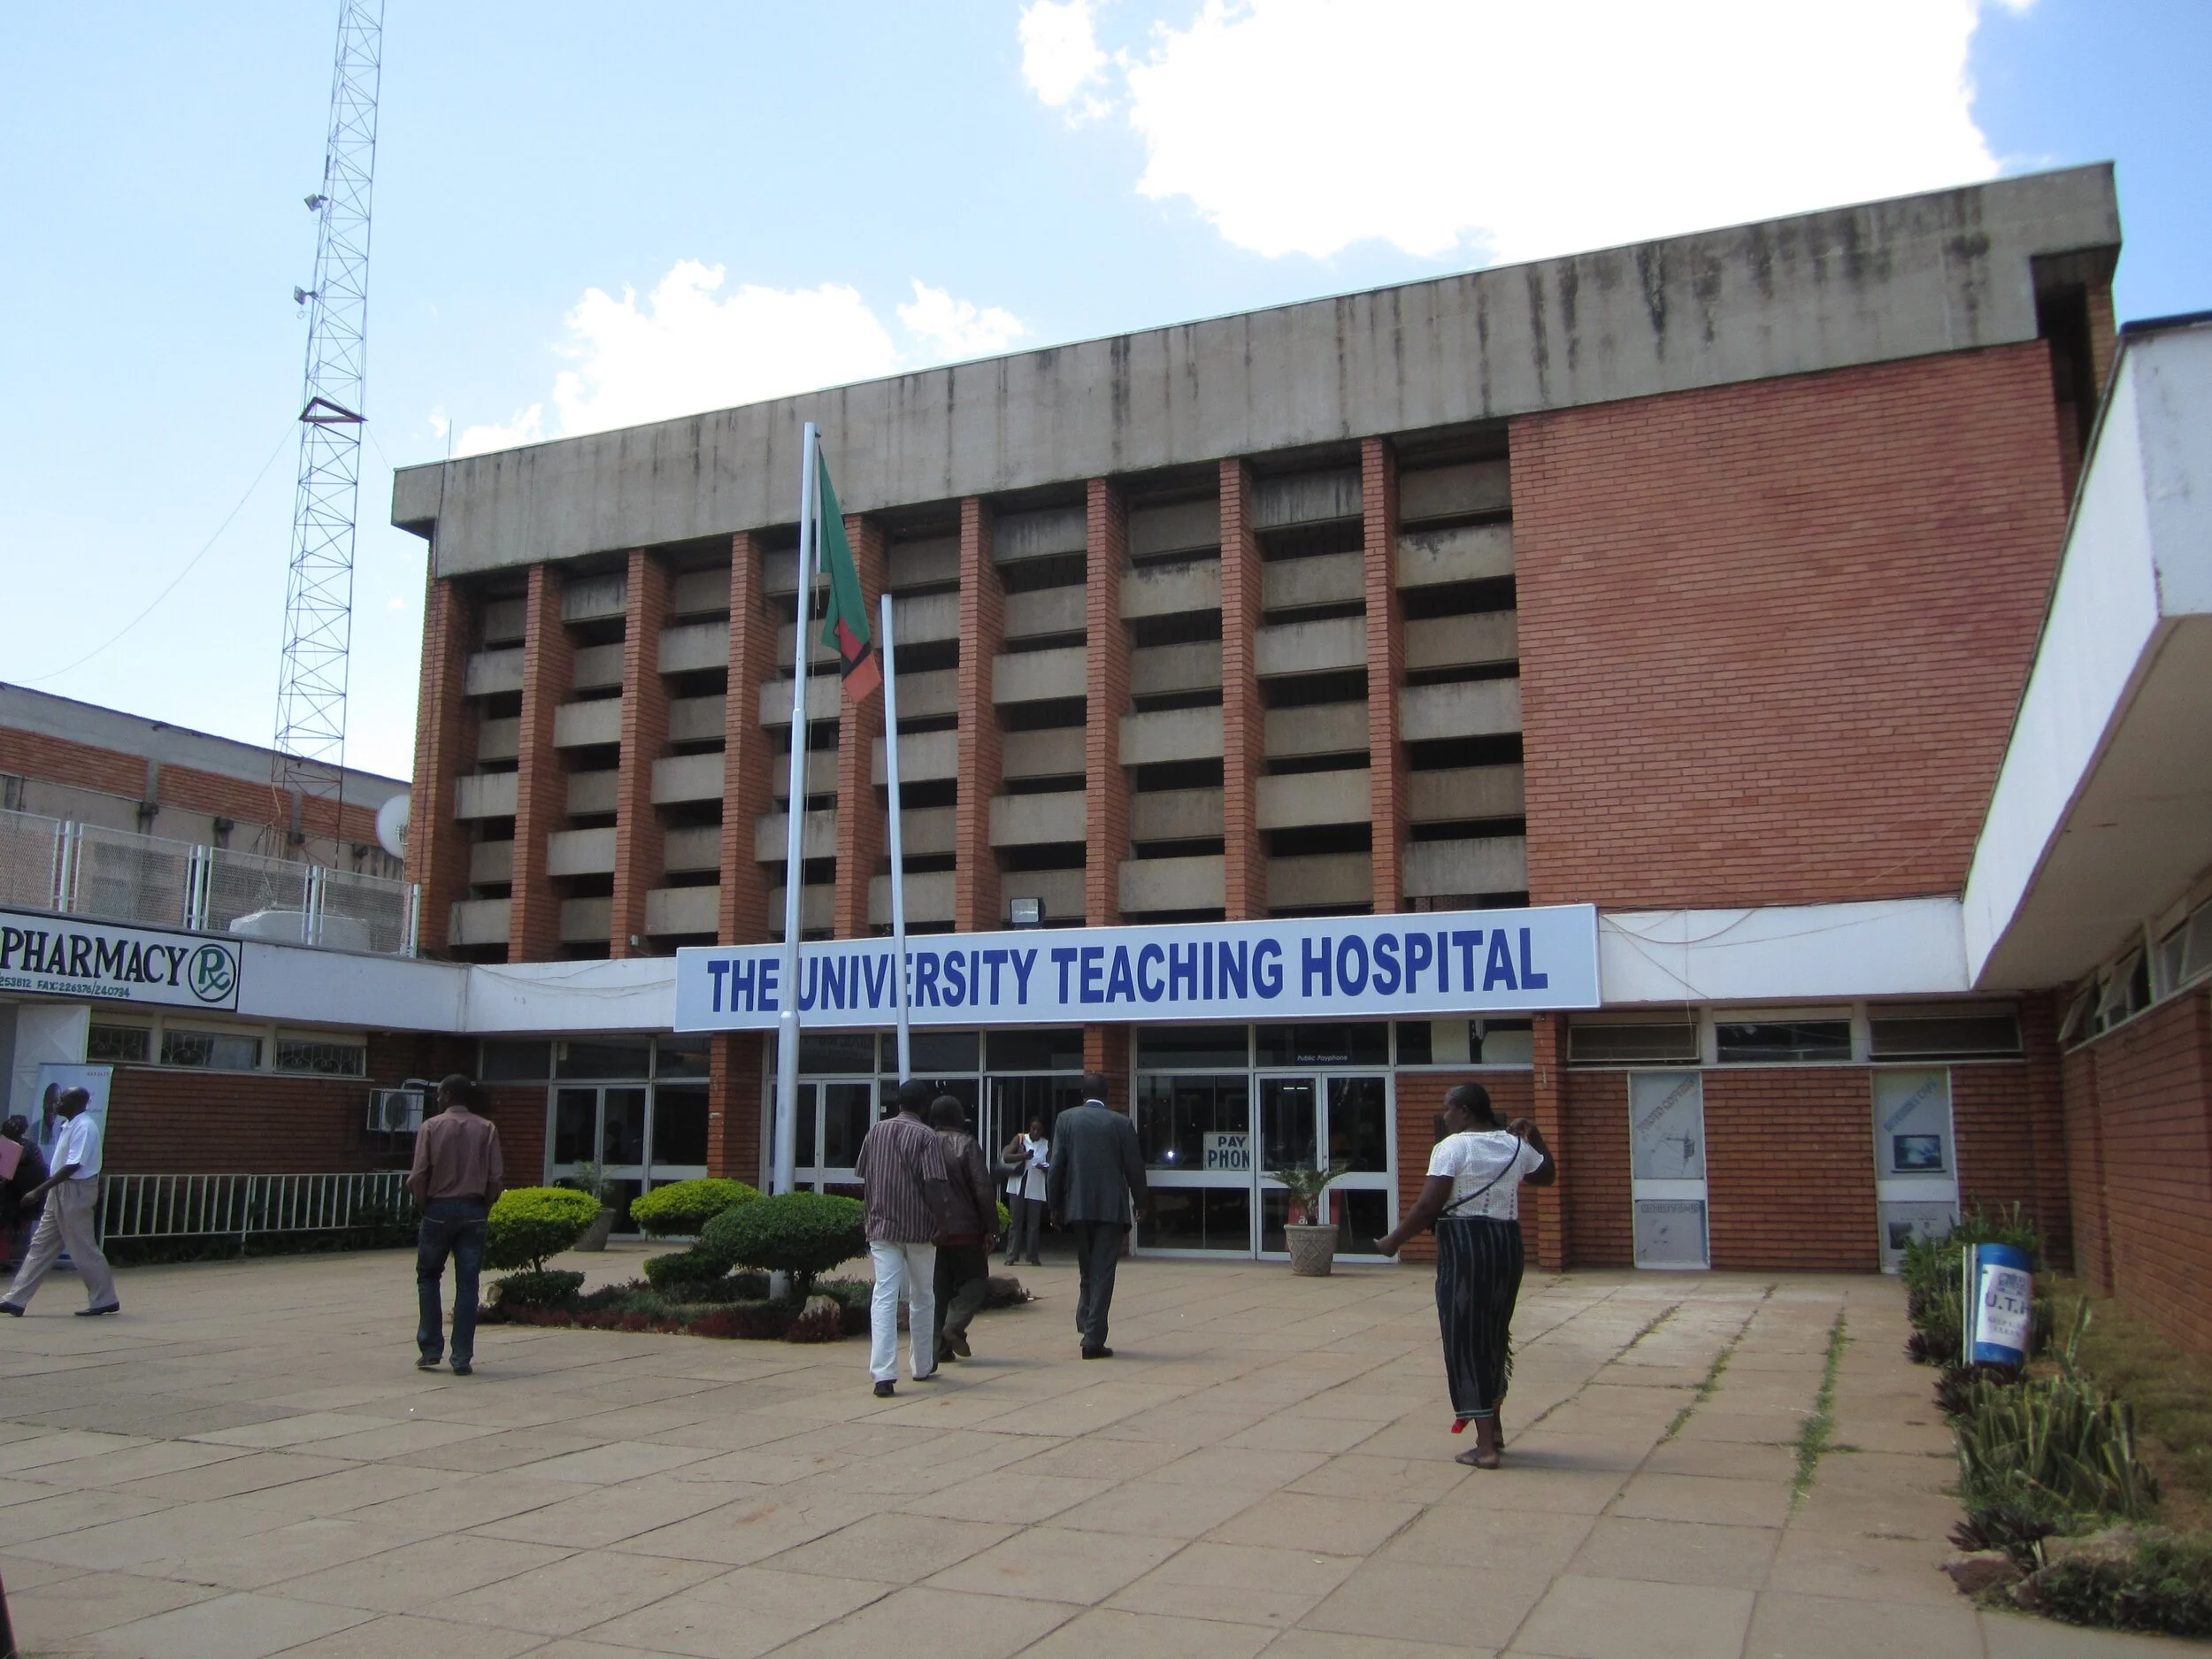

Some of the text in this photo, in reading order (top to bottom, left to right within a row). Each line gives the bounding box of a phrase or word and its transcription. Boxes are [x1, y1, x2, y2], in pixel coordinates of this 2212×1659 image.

[0, 926, 189, 986] PHARMACY
[708, 927, 1548, 1012] THE UNIVERSITY TEACHING HOSPITAL
[1208, 1149, 1249, 1168] PHON
[1217, 1135, 1247, 1148] PAY
